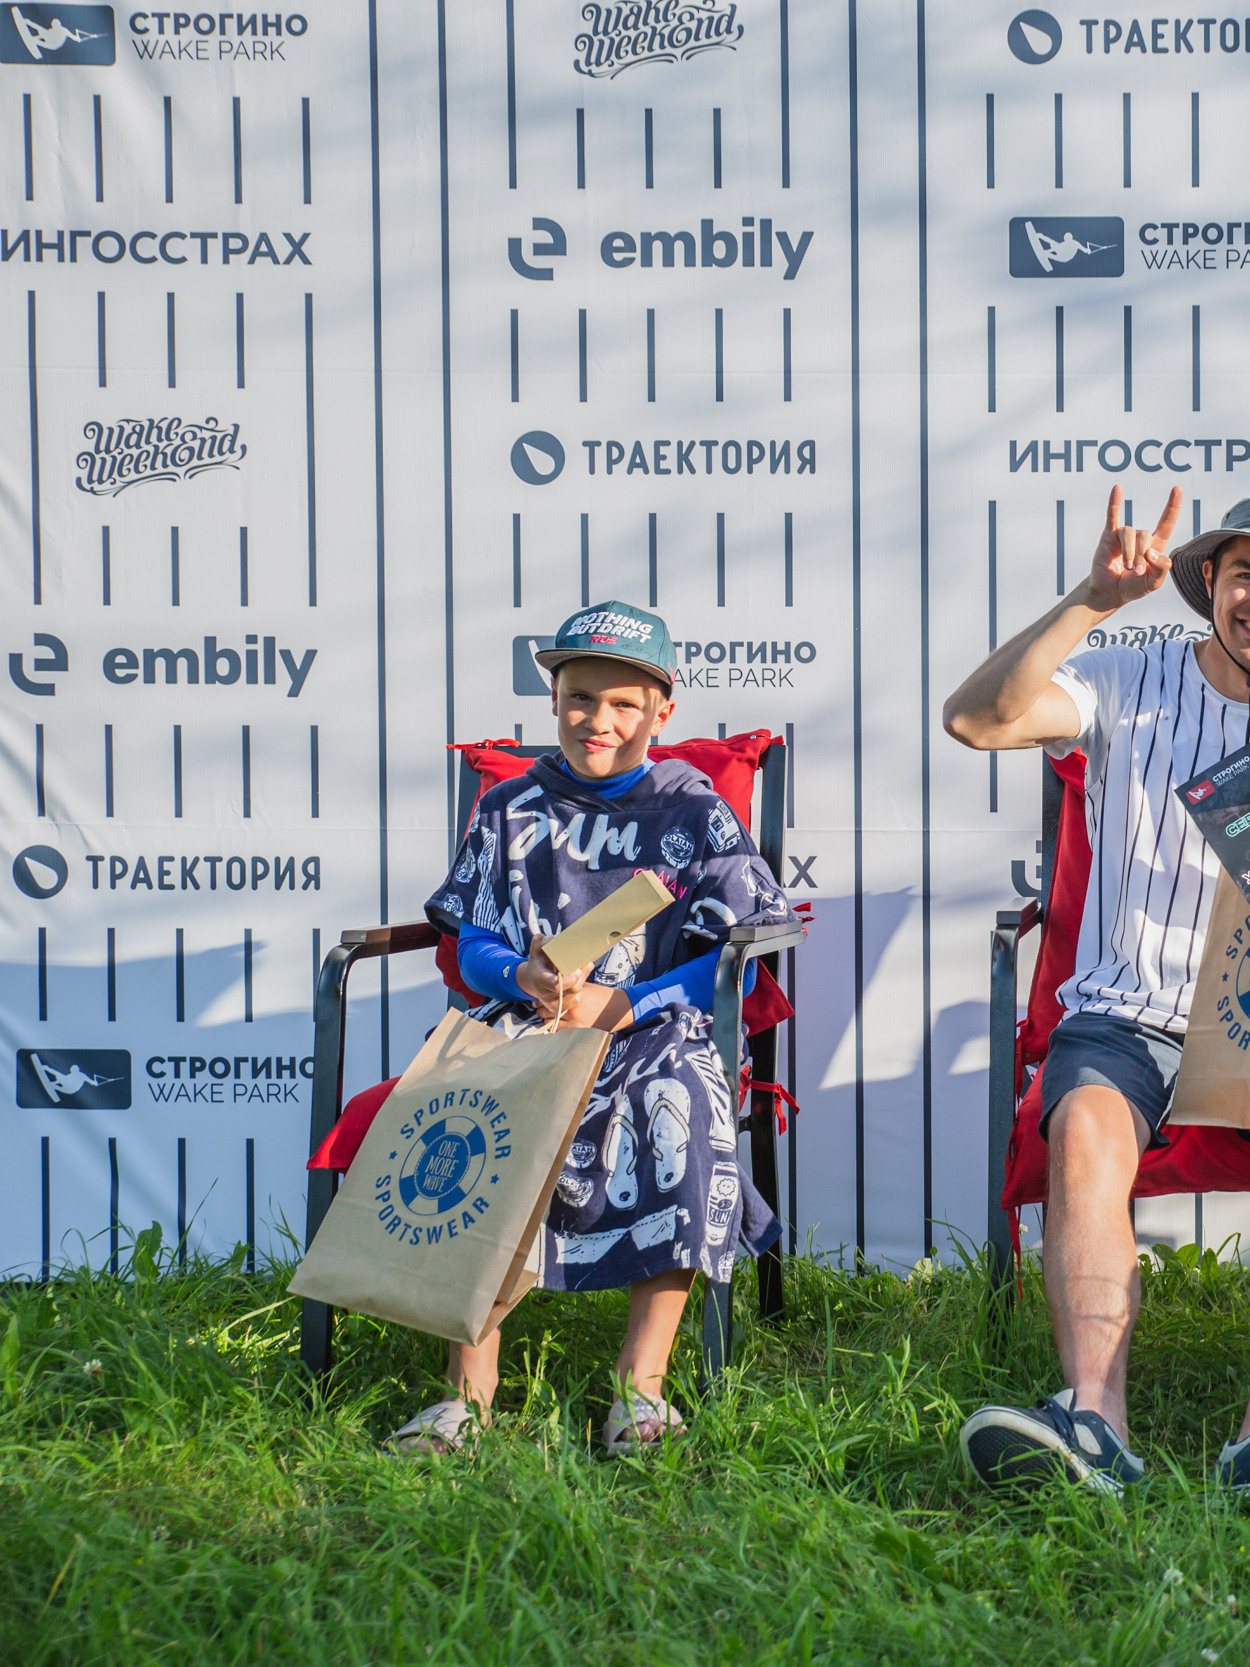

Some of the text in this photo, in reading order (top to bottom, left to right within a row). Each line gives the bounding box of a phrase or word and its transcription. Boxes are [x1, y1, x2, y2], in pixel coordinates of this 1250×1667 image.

[129, 12, 308, 36] СТРОГИНО
[132, 39, 286, 61] WAKE PARK
[0, 229, 312, 265] ИНГОССТРАХ
[601, 217, 814, 280] embily
[1141, 250, 1217, 269] WAKE
[582, 440, 815, 475] ТРАЕКТОРИЯ
[571, 612, 653, 634] NOTHING
[673, 642, 816, 664] ТРОГИНО
[103, 635, 317, 697] embily
[673, 668, 794, 687] AKE PARK
[1212, 755, 1250, 782] СТРОГИНО
[1216, 764, 1249, 787] WAKE PARK
[86, 855, 320, 890] ТРАЕКТОРИЯ
[148, 1083, 299, 1103] WAKE PARK
[400, 1088, 512, 1160] SPORTSWEAR
[438, 1140, 460, 1158] ONE
[424, 1155, 459, 1178] MORE
[422, 1174, 447, 1193] WAVE
[375, 1174, 490, 1246] SPORTSWEAR
[709, 1208, 730, 1224] SUN
